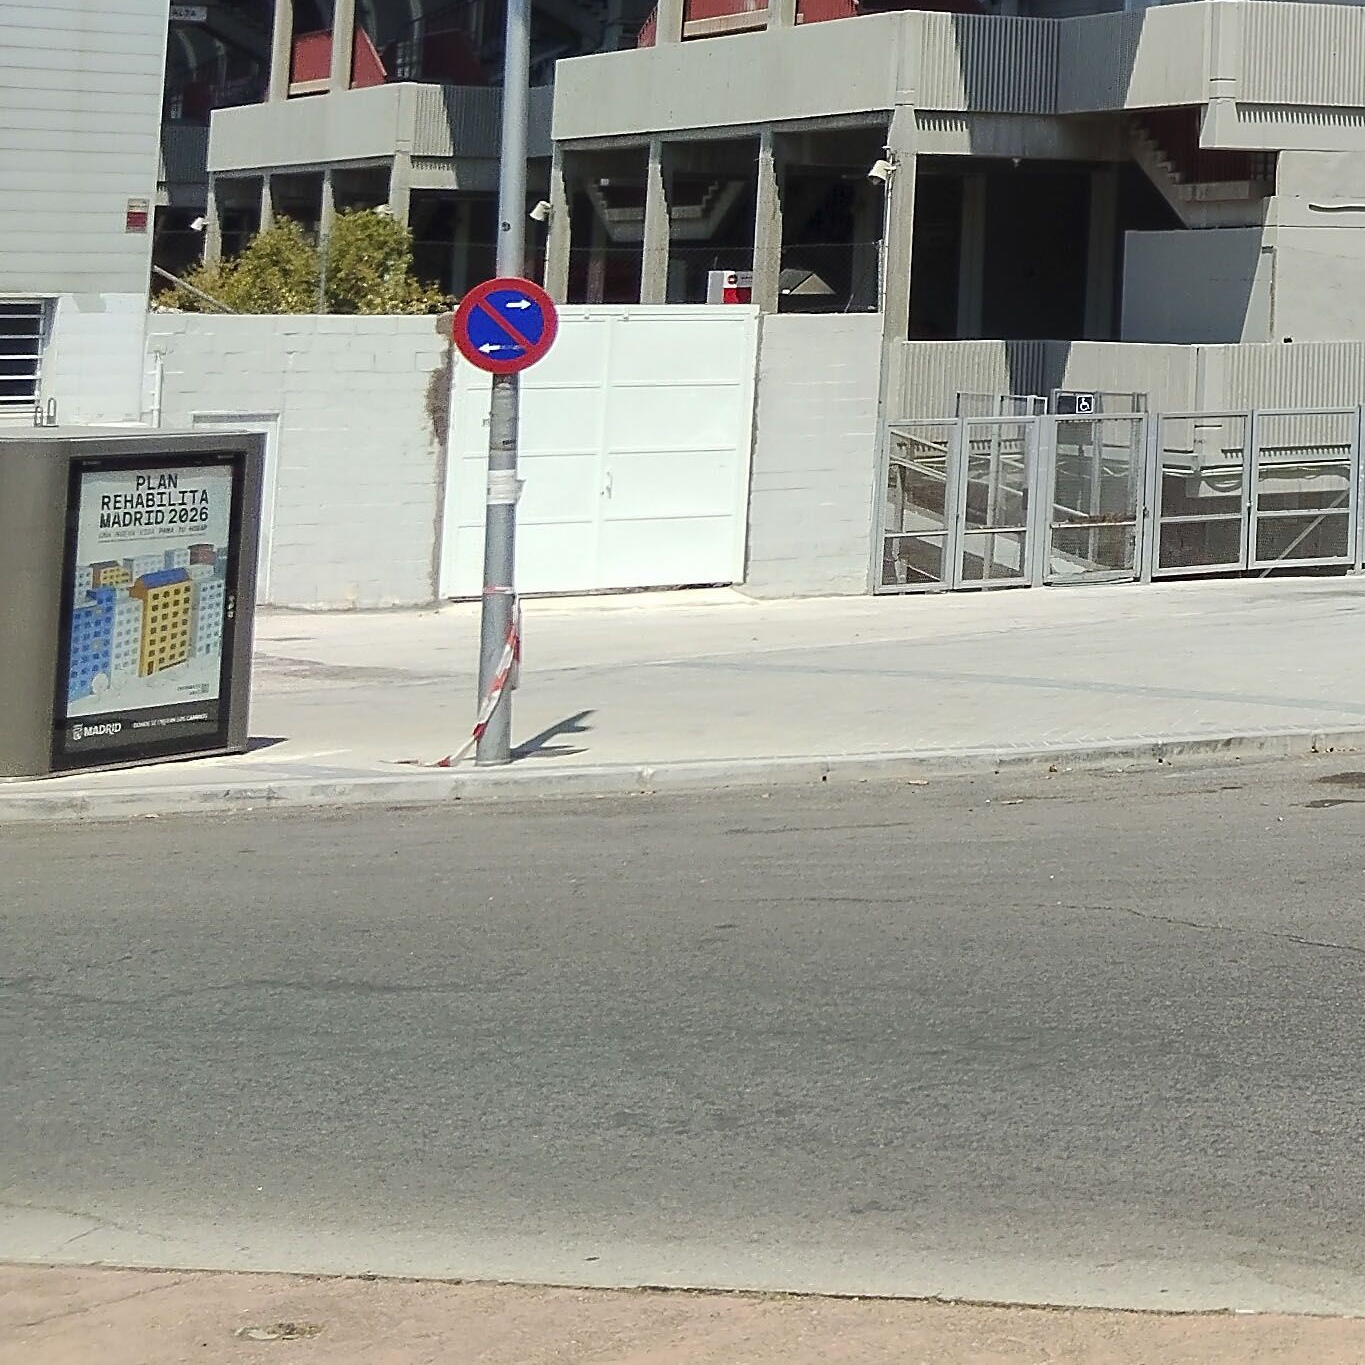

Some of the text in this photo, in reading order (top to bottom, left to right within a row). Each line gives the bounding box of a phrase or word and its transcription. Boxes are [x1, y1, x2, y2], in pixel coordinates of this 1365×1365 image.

[136, 474, 178, 491] PLAN
[101, 490, 208, 510] REHABILITA
[100, 508, 208, 528] MADRID 2026
[84, 722, 121, 737] MADRID
